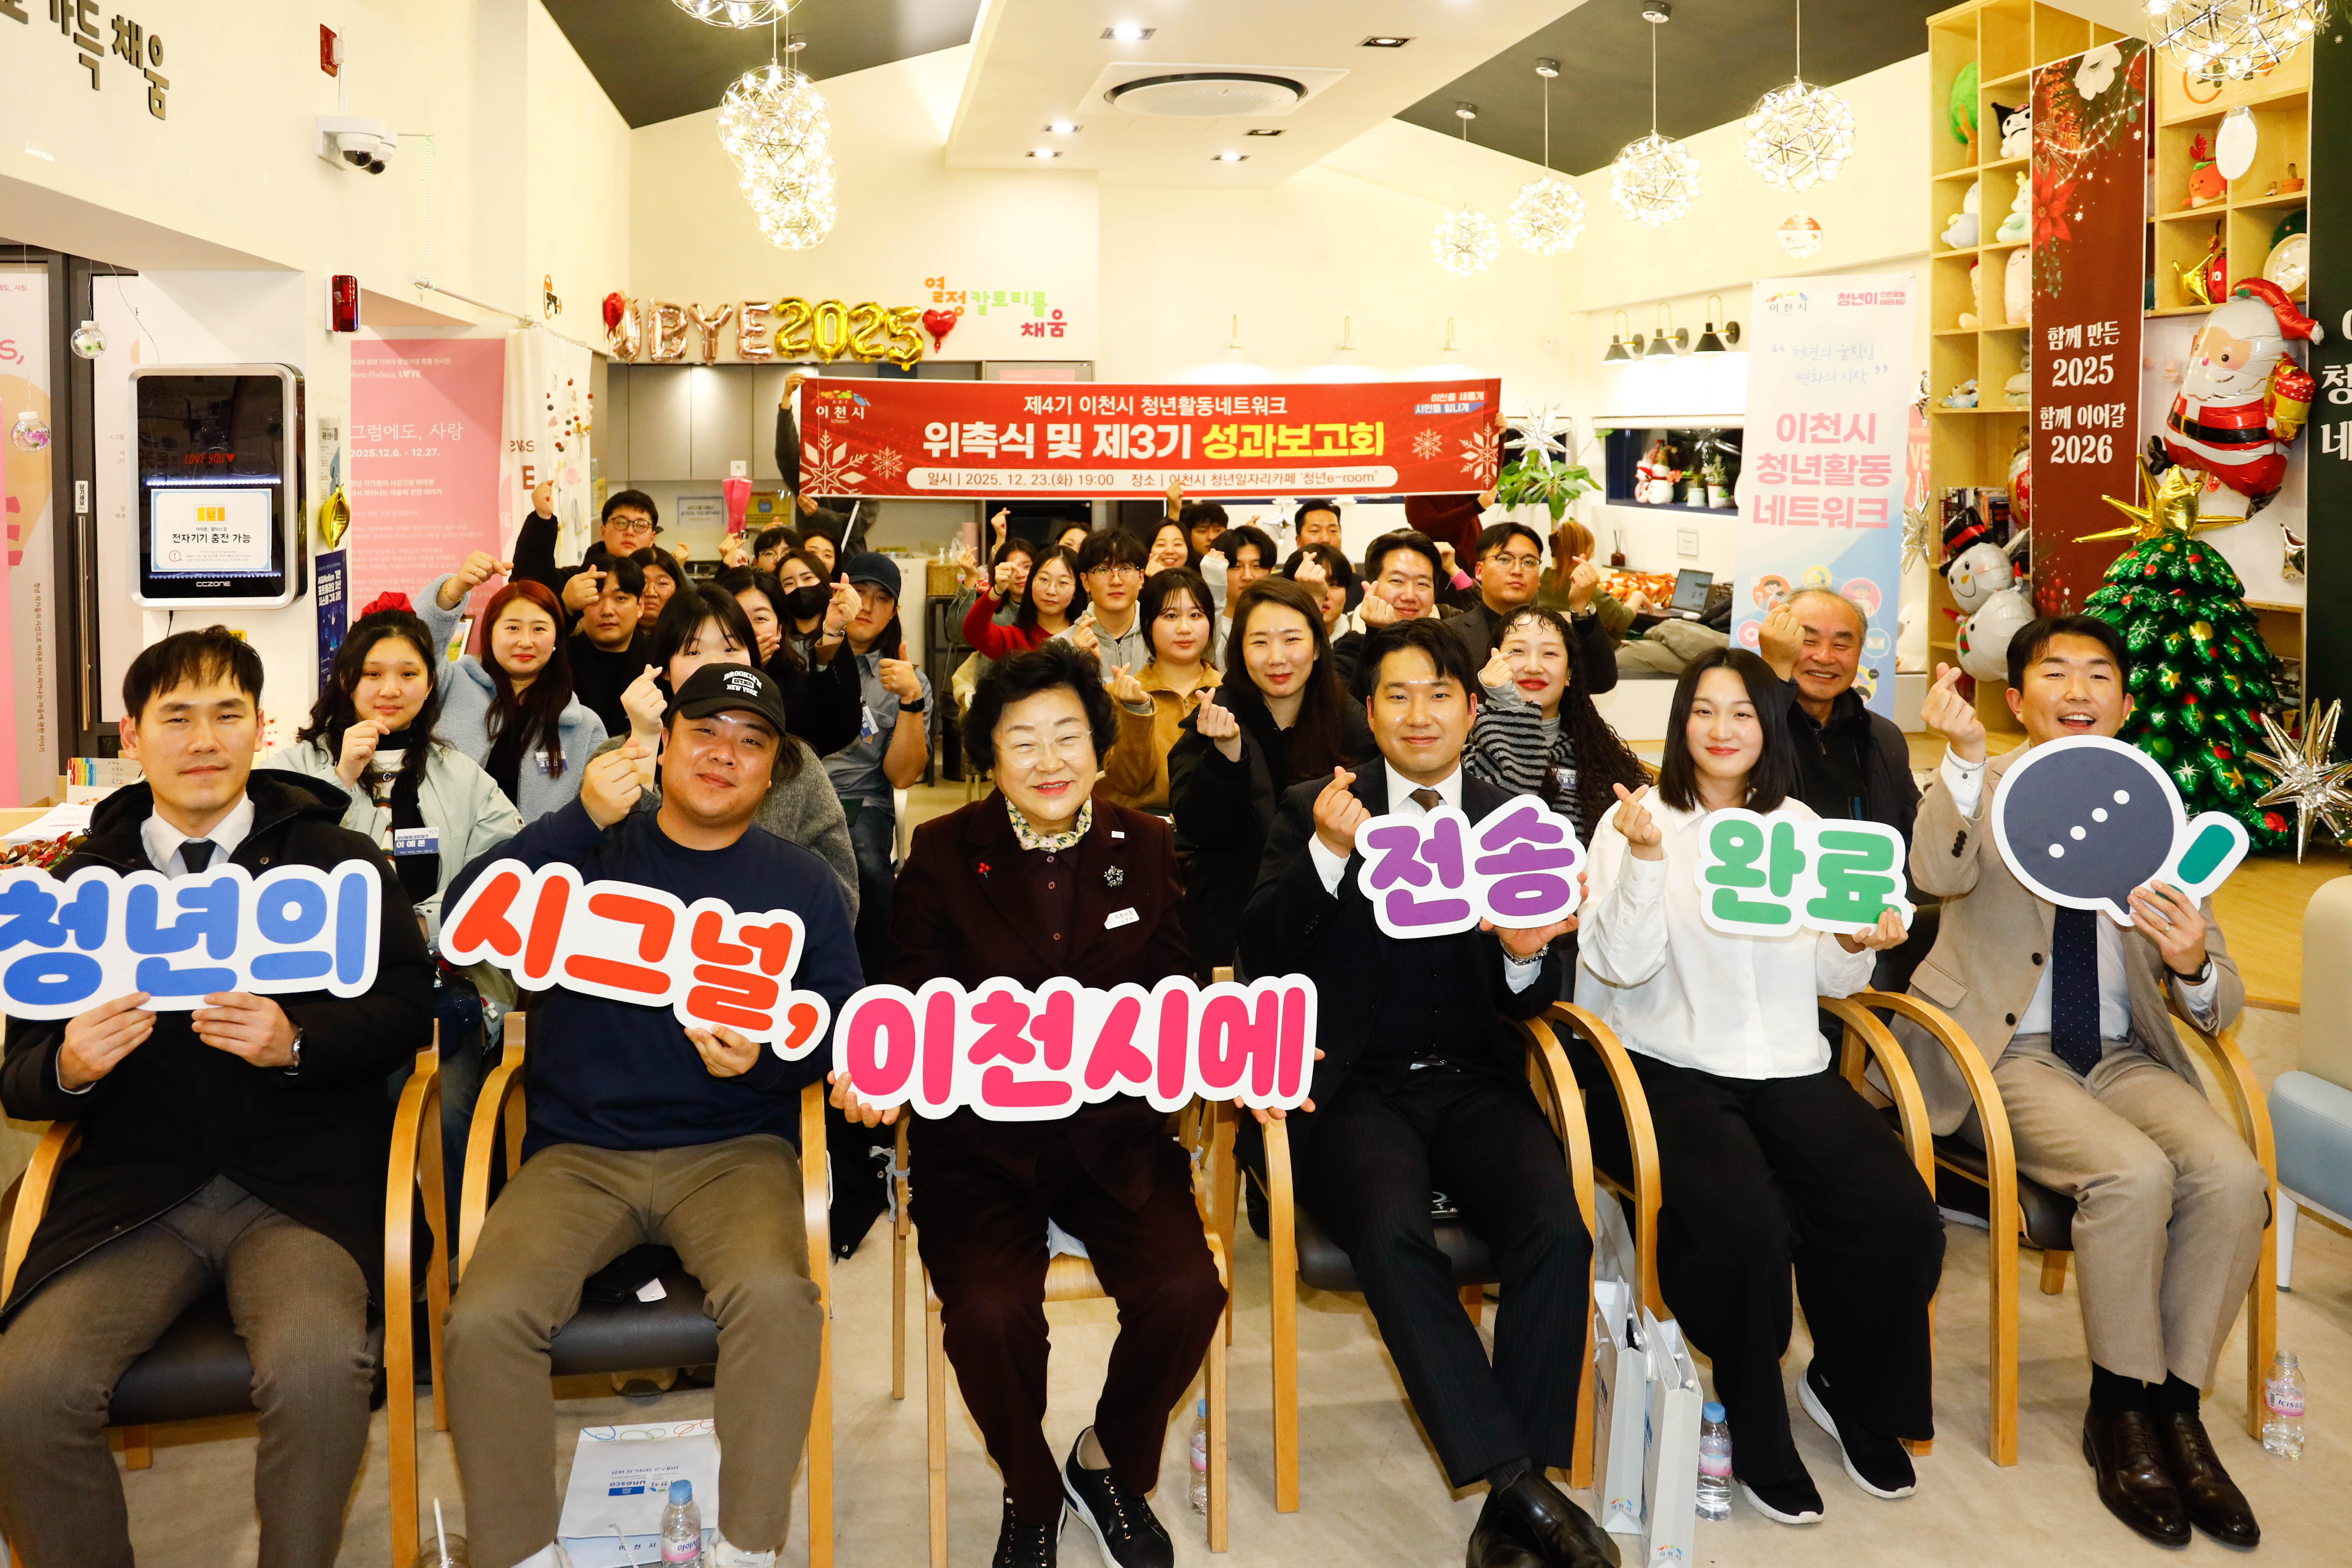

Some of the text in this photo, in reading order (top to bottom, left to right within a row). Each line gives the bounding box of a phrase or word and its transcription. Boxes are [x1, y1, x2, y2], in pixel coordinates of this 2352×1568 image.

[112, 15, 169, 120] 채움
[925, 276, 1048, 317] 열정 칼로리를
[1837, 292, 1878, 306] 청년이
[1769, 303, 1807, 313] 이천시
[1021, 309, 1067, 337] 채움
[775, 296, 924, 371] 2025
[2047, 320, 2120, 351] 함께 만든
[1792, 343, 1874, 361] 청년의 움직임
[1796, 369, 1869, 386] 변화의 시작
[2052, 353, 2114, 388] 2025
[1024, 396, 1288, 416] 제4기 이천시 청년활동네트워크
[1431, 391, 1484, 402] 이천을 새롭게
[816, 406, 864, 419] 이천시
[1415, 404, 1441, 413] 시민을
[2040, 402, 2127, 430] 함께 이어갈
[351, 422, 463, 442] 그럼에도, 사랑
[1776, 412, 1876, 444] 이천시
[923, 421, 1384, 459] 위촉식 및 제3기 성과보고회
[2050, 435, 2113, 464] 2026
[184, 453, 225, 464] LOVE YOU
[351, 449, 402, 457] 2025.12.6.
[411, 449, 440, 457] 12.27.
[927, 472, 952, 485] 일시
[965, 473, 1002, 485] 2025.
[1008, 473, 1026, 485] 12.
[1031, 473, 1073, 487] 23.(화)
[1078, 473, 1113, 485] 19:00
[1131, 474, 1155, 486] 장소
[1169, 474, 1205, 486] 이천시
[1211, 472, 1295, 486] 청년일자리카페
[1756, 453, 1892, 487] 청년활동
[1753, 494, 1889, 529] 네트워크
[172, 534, 251, 543] 전자기기 충전 가능
[37, 664, 43, 675] 다시
[723, 671, 762, 689] BROOKLYN
[742, 686, 758, 697] YORK
[1367, 806, 1575, 927] 전송
[1705, 819, 1901, 925] 완료
[0, 873, 367, 1005] 청년의
[452, 871, 818, 1049] 시그널,
[846, 987, 1305, 1107] 이천시에
[1612, 1504, 1631, 1513] 이천시
[1659, 1552, 1681, 1561] 이천시
